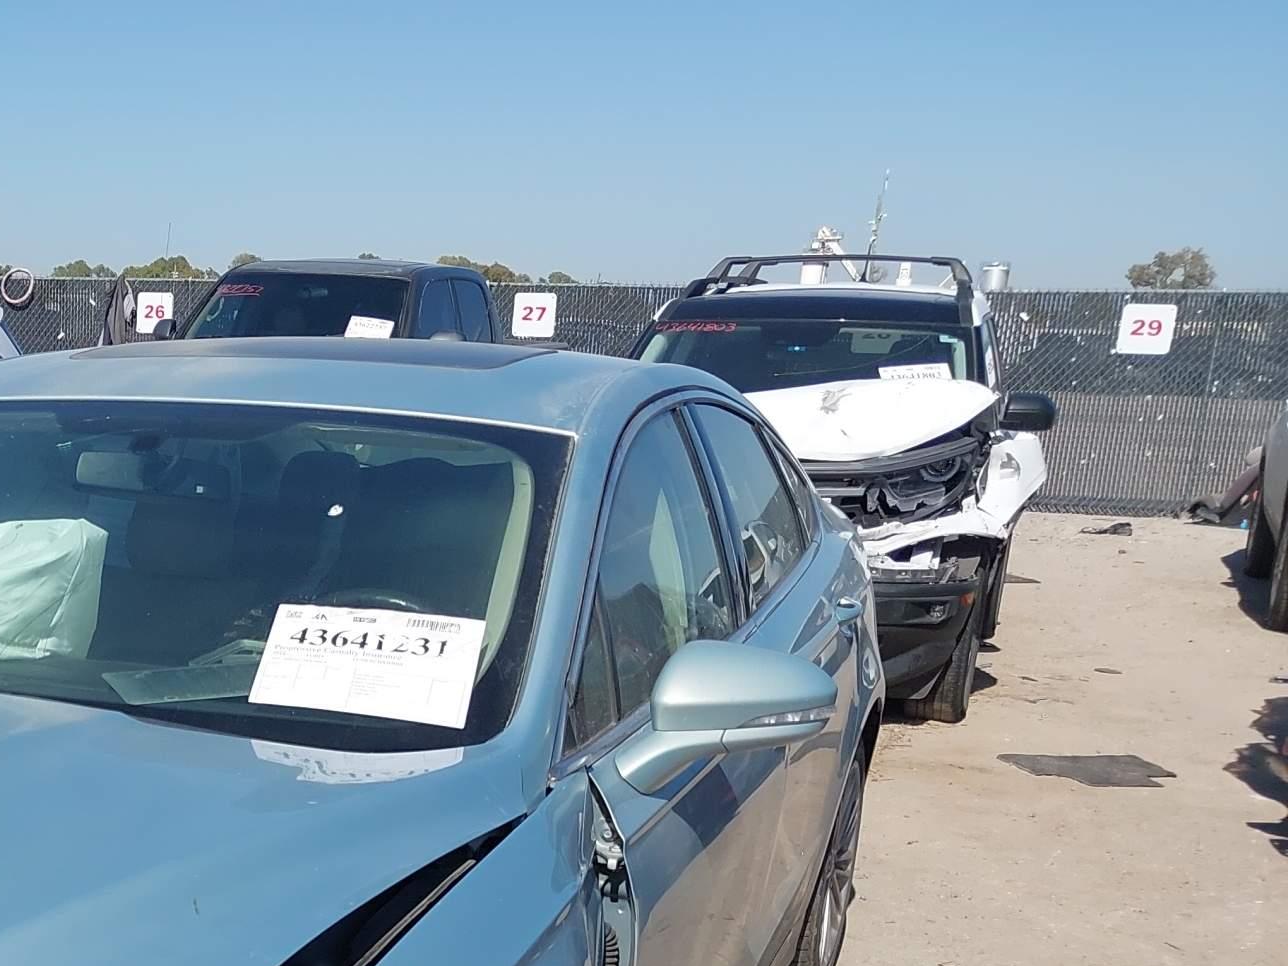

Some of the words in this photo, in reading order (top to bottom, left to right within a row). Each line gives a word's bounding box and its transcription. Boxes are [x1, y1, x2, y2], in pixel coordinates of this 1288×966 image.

[144, 304, 165, 319] 26
[521, 306, 547, 321] 27
[1130, 319, 1163, 337] 29
[289, 627, 449, 658] 43641231
